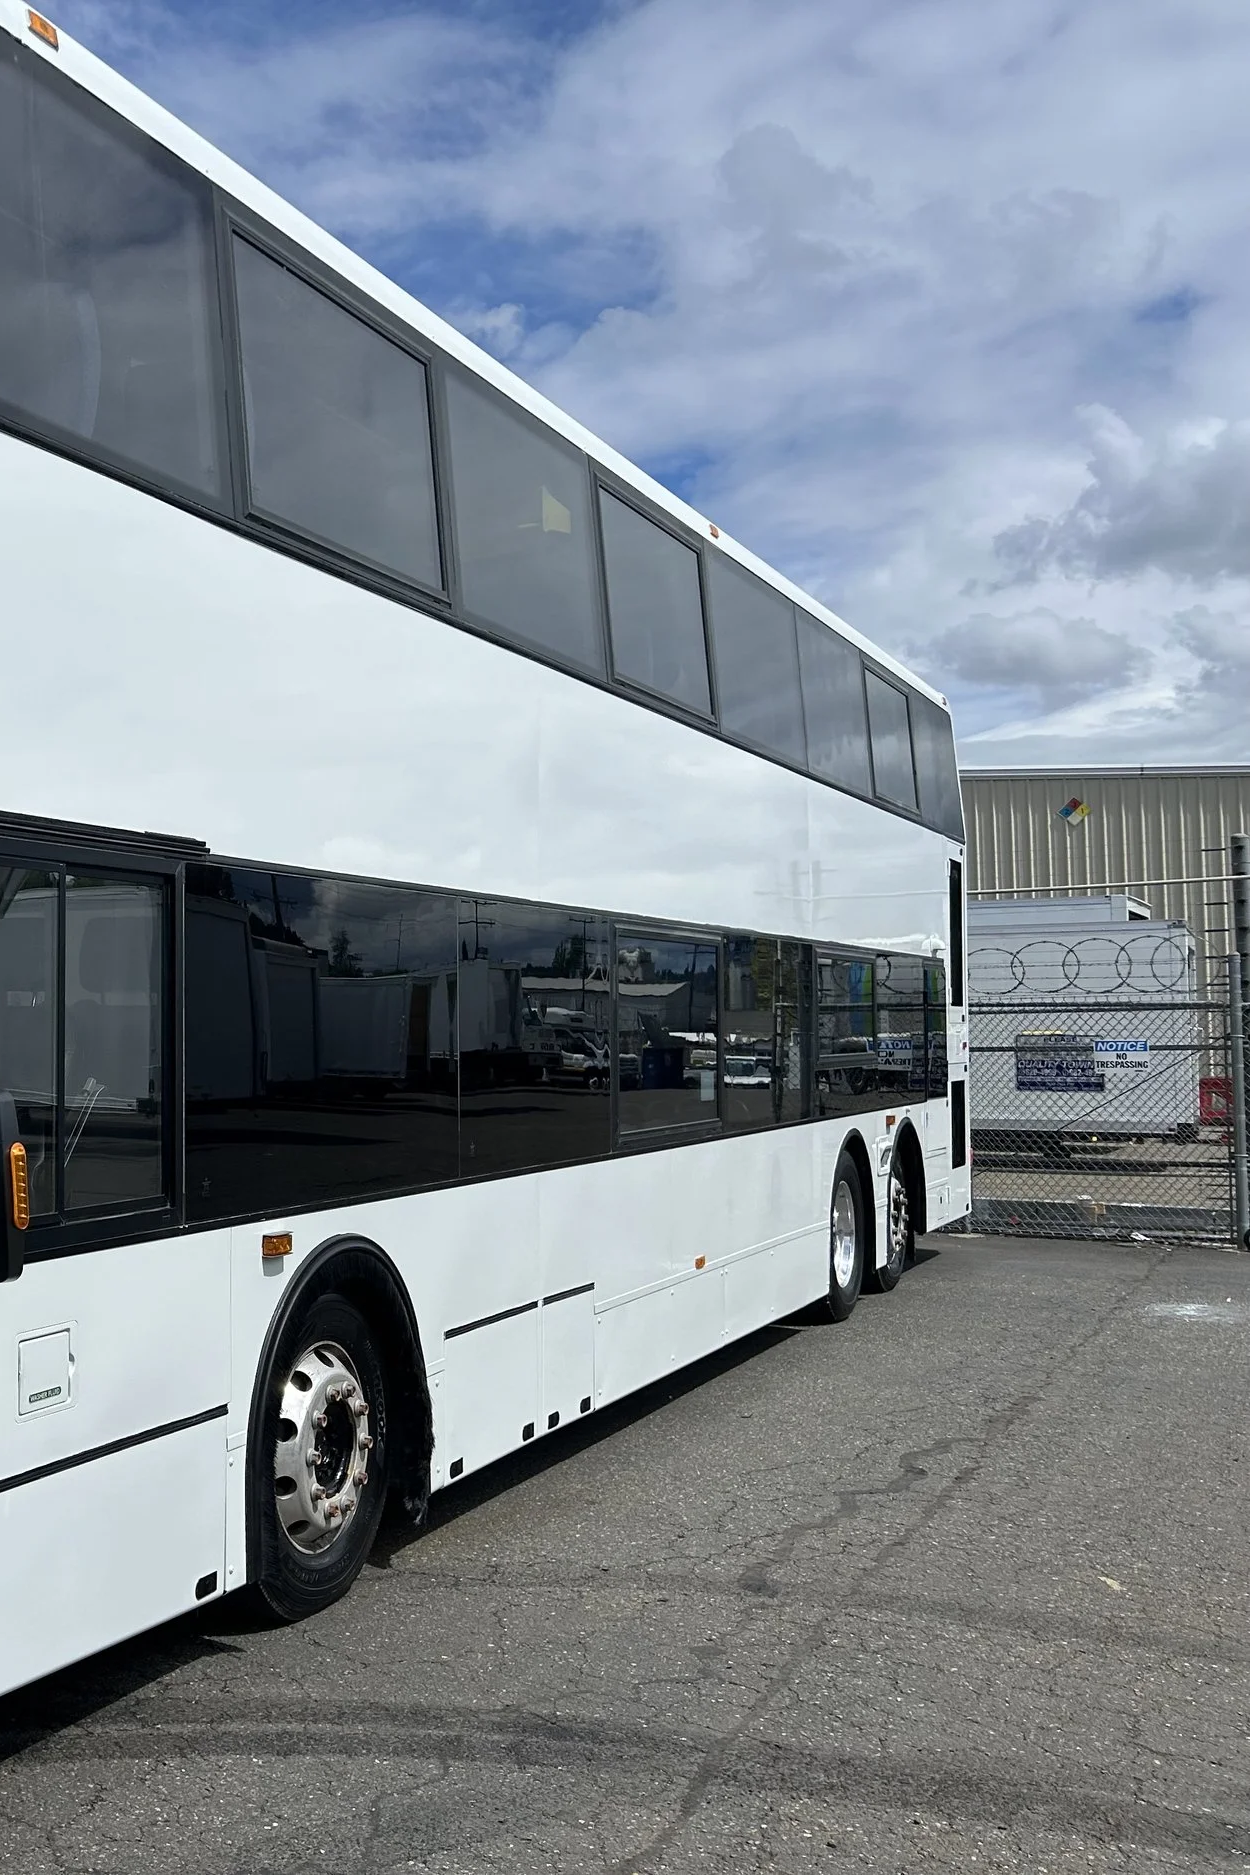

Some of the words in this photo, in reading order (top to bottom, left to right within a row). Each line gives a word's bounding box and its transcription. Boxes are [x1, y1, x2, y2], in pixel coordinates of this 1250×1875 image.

[1097, 1041, 1145, 1051] NOTICE
[1018, 1060, 1060, 1069] QUALITY
[1062, 1060, 1094, 1069] TOWIN
[1096, 1060, 1149, 1068] TRESPASSING
[30, 1391, 48, 1402] WASHER
[48, 1387, 61, 1398] FLUID
